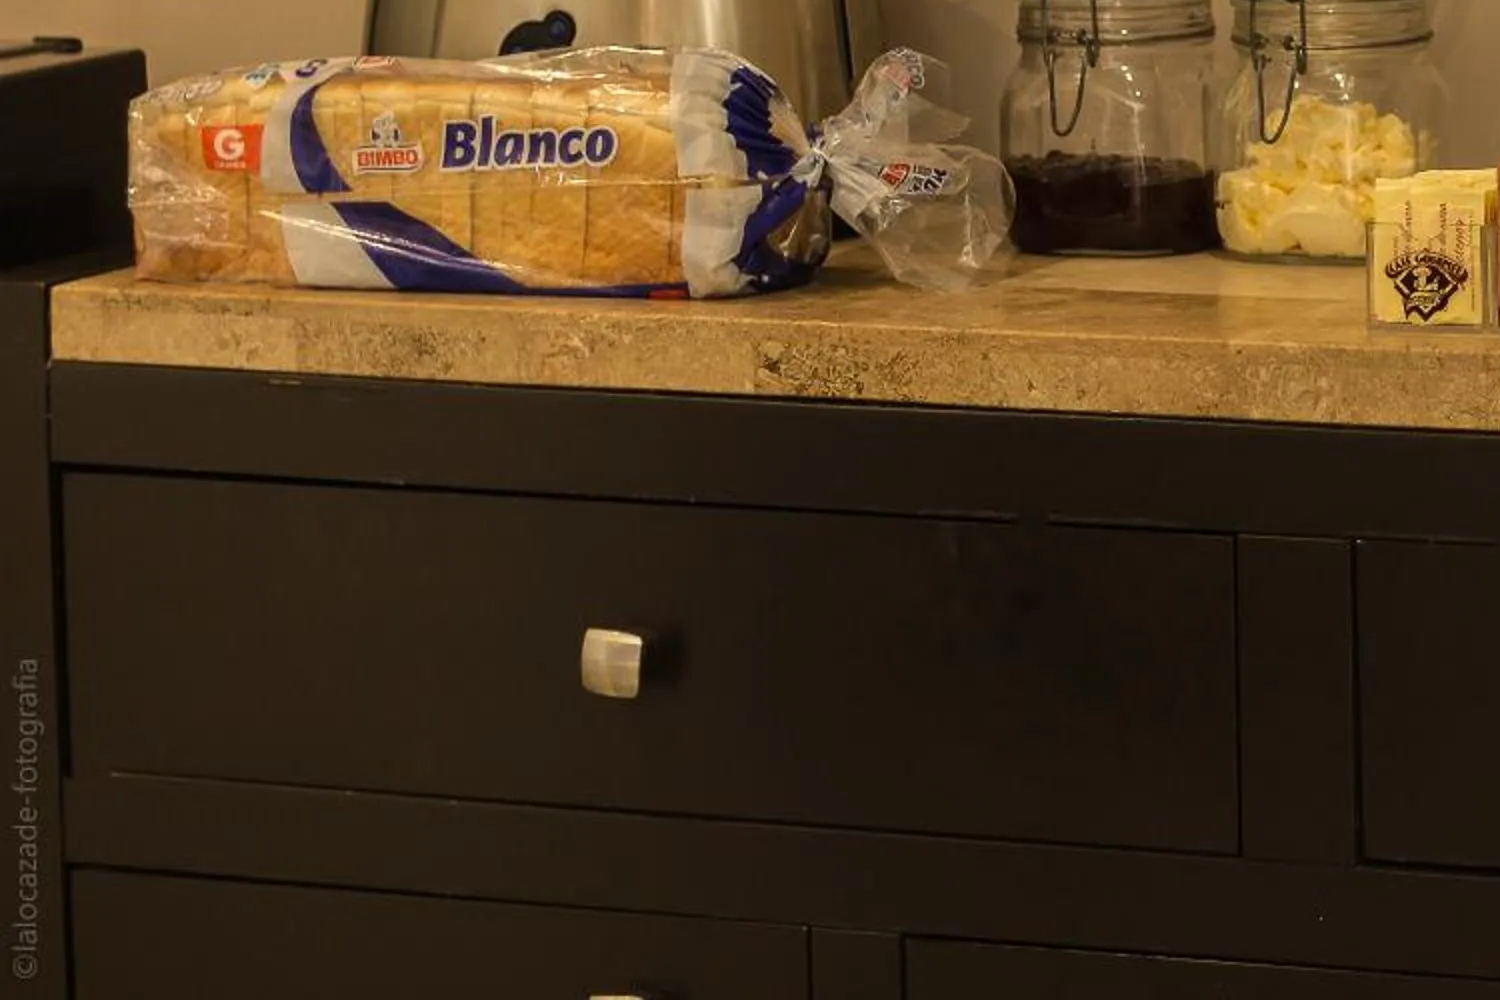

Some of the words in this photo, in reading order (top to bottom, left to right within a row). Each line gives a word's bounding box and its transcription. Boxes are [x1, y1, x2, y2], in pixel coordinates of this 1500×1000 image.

[213, 128, 245, 161] G
[357, 150, 418, 167] BIMBO
[441, 115, 616, 169] Blanco
